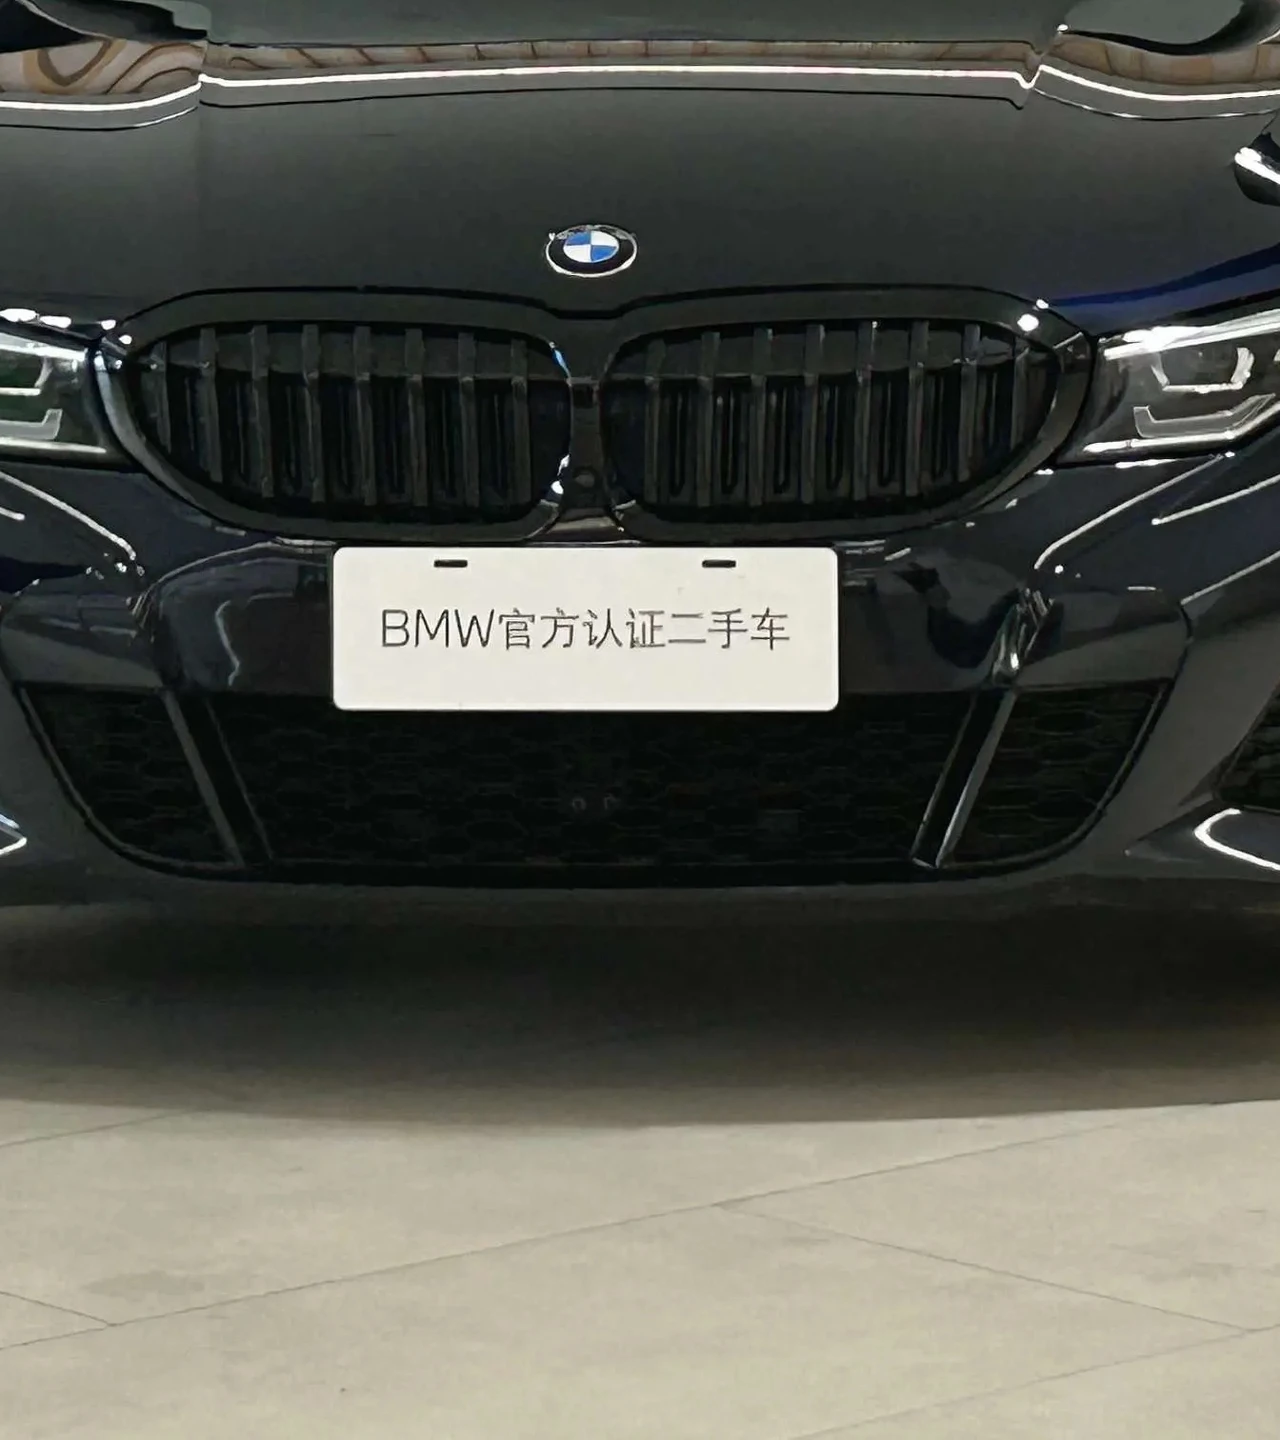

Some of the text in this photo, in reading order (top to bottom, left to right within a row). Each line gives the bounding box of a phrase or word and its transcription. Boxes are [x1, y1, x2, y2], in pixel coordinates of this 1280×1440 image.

[381, 606, 791, 651] BMW官方认证二手车
